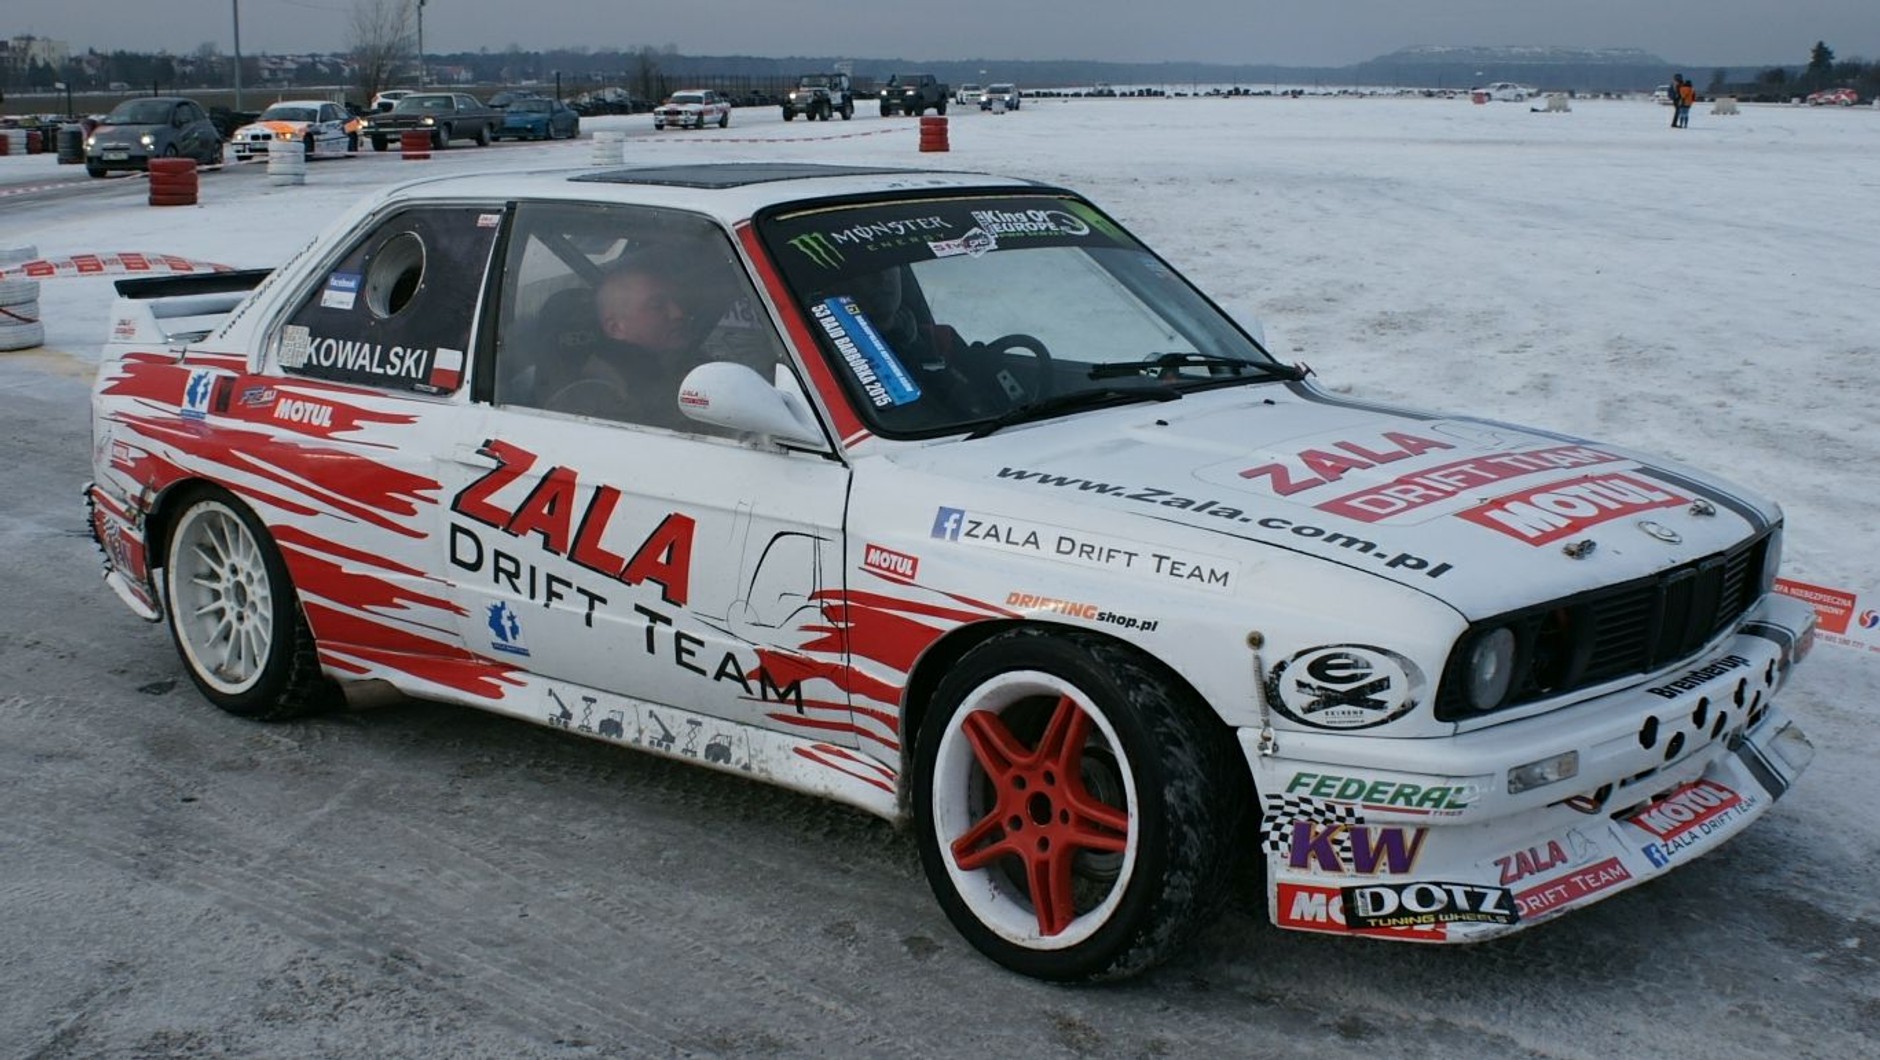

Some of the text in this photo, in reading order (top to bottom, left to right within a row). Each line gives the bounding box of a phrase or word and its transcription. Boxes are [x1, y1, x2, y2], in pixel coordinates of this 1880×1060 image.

[982, 210, 1027, 223] King
[993, 221, 1060, 233] EUROPE
[811, 304, 831, 318] 53
[820, 316, 846, 339] RAJD
[304, 336, 429, 379] KOWALSKI
[273, 398, 333, 427] MOTUL
[865, 382, 893, 406] 2015
[1238, 431, 1457, 497] ZALA
[1345, 463, 1490, 516] DRIFT
[1482, 478, 1677, 538] MOTUL
[450, 438, 697, 608] ZALA
[996, 466, 1455, 579] www.Zala.com.pl
[867, 547, 915, 577] MOTUL
[964, 519, 1041, 550] ZALA
[1055, 536, 1139, 568] DRIFT
[1151, 553, 1231, 587] TEAM
[450, 521, 805, 715] DRIFT TEAM
[1285, 772, 1469, 809] FEDERAL
[1640, 782, 1733, 833] MOTUL
[1289, 820, 1431, 876] KW
[1661, 831, 1701, 856] ZALA
[1701, 811, 1734, 836] DRIFT
[1734, 796, 1757, 815] TEAM
[1493, 840, 1568, 886] ZALA
[1355, 883, 1512, 917] DOTZ
[1514, 864, 1627, 916] DRIFT TEAM
[1366, 913, 1508, 927] TUNING WHEELS
